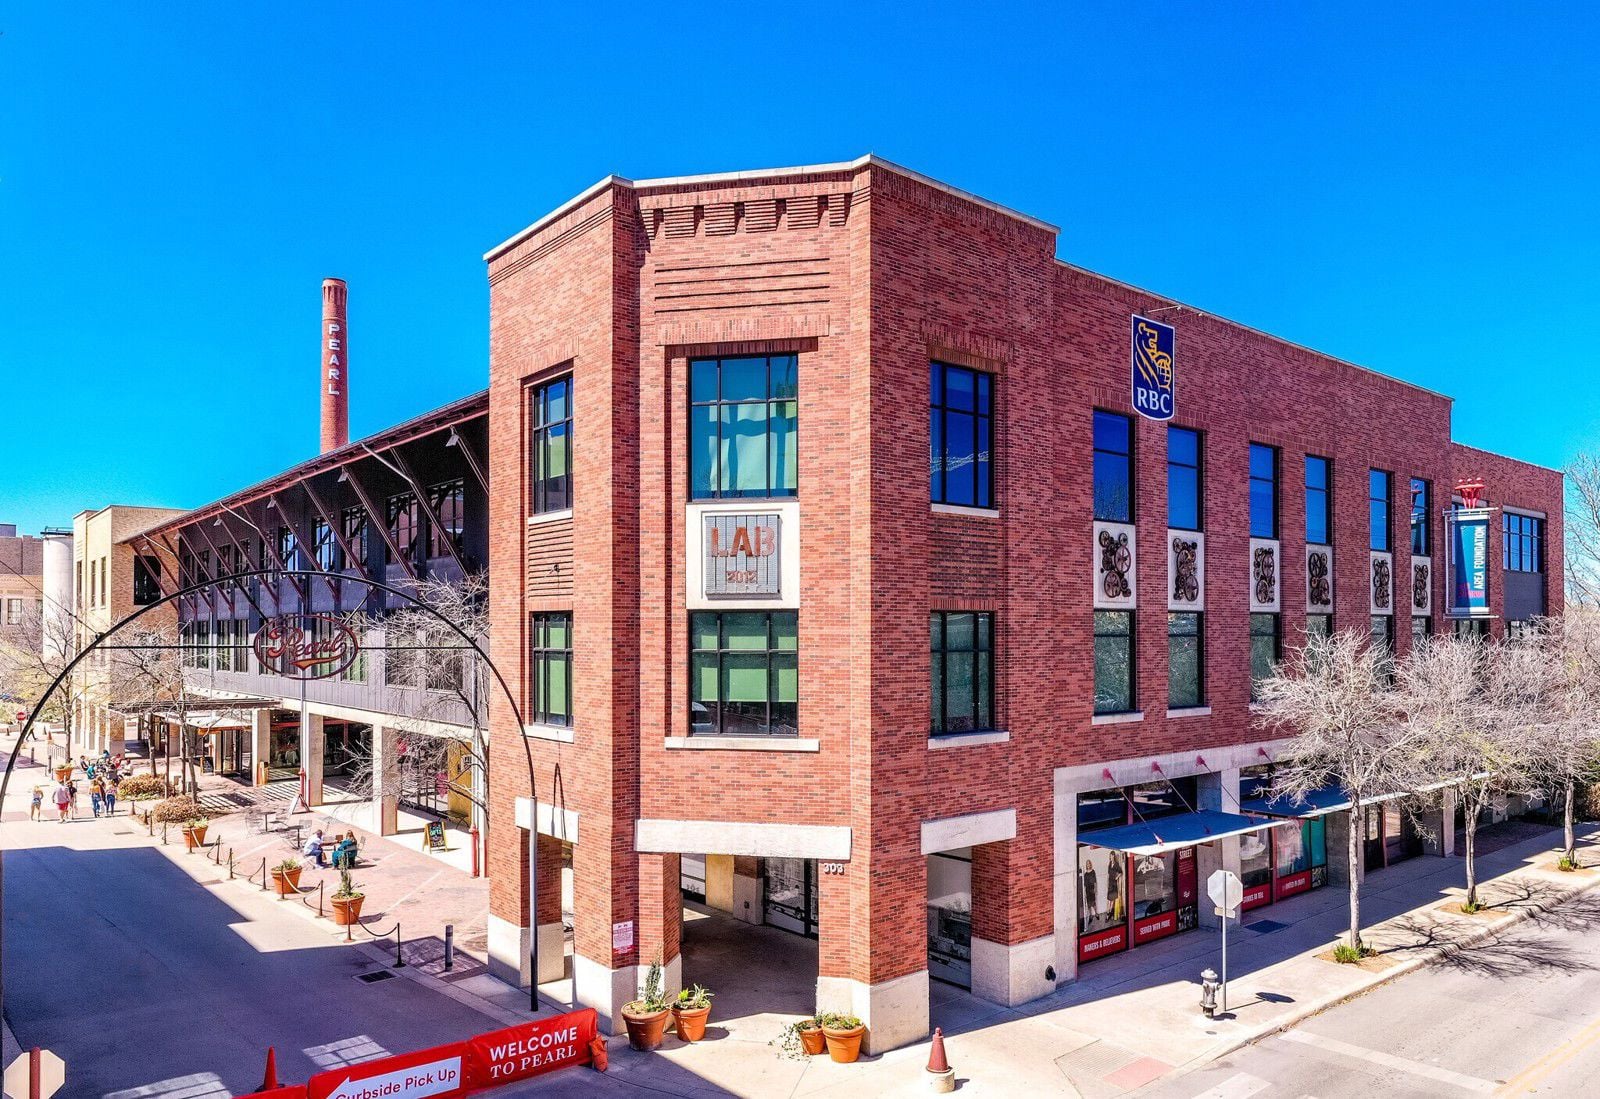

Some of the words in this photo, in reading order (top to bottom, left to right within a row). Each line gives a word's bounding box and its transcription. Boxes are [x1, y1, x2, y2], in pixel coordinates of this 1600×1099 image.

[328, 324, 341, 395] PEARL
[1136, 386, 1170, 414] RBC
[711, 526, 775, 558] LAB
[1473, 525, 1486, 569] FOUNDATION
[1473, 571, 1485, 590] AREA
[267, 626, 347, 664] Pearl
[823, 862, 844, 875] 303
[489, 1026, 578, 1062] WELCOME
[490, 1061, 515, 1079] TO
[520, 1044, 577, 1071] PEARL
[405, 1073, 433, 1090] Pick
[438, 1068, 456, 1081] Up
